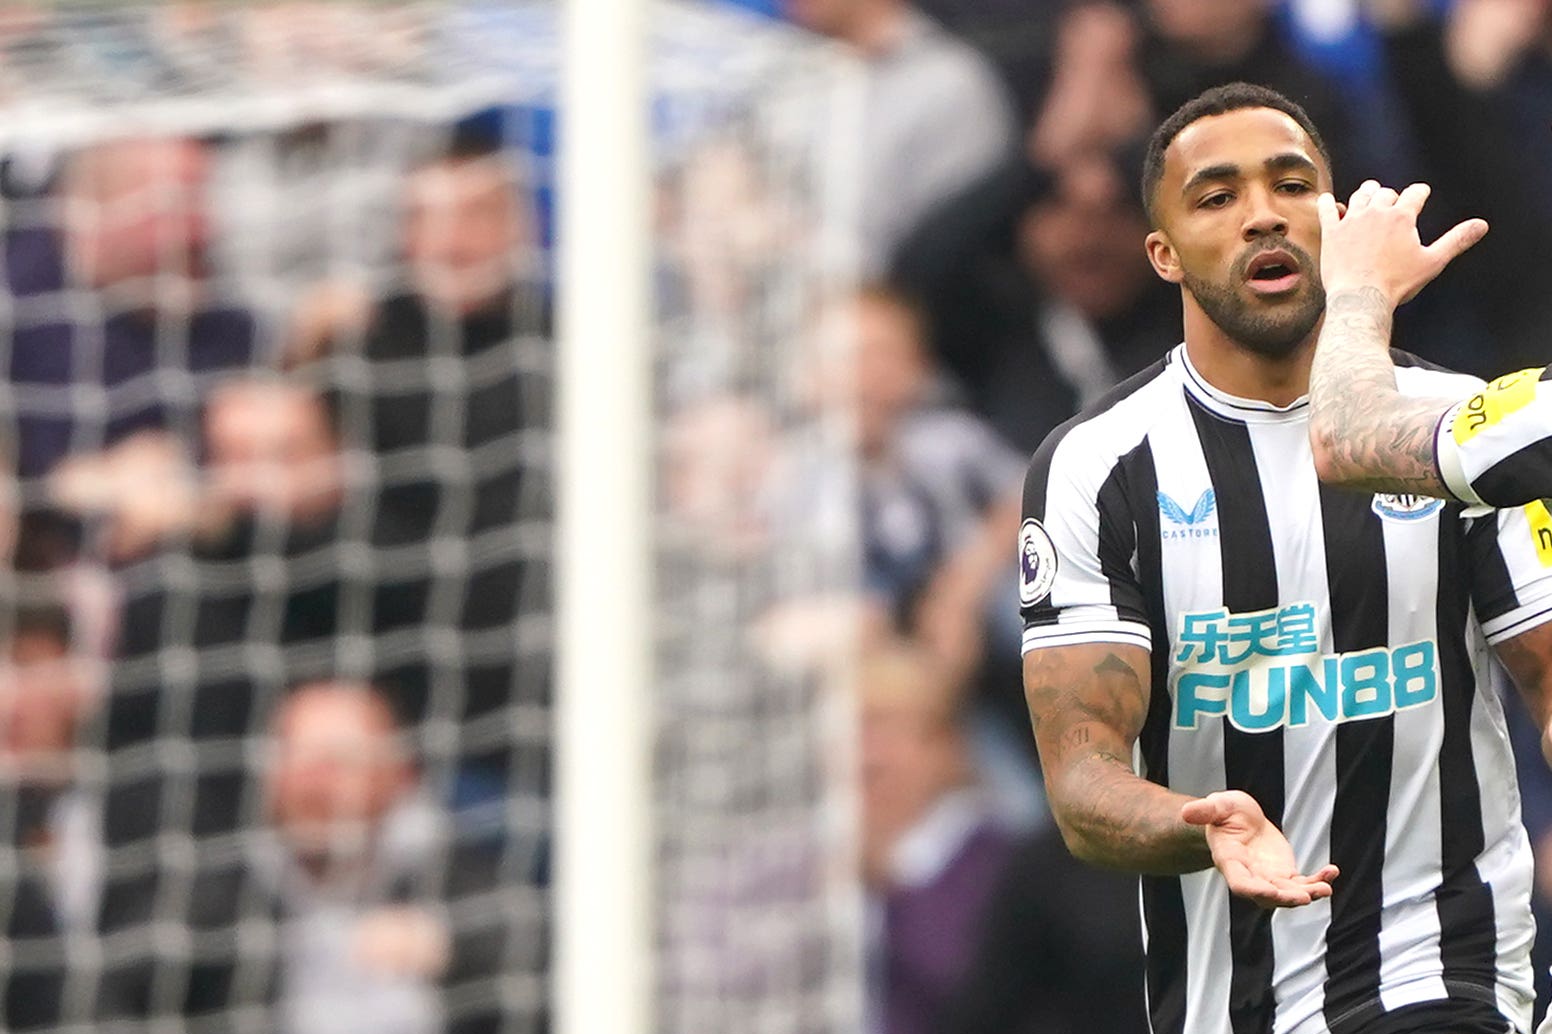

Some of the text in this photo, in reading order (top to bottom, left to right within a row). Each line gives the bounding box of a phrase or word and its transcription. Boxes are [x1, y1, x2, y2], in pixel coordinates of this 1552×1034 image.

[1162, 528, 1218, 540] CASTORE
[1175, 602, 1319, 667] 乐天堂
[1173, 640, 1438, 730] FUN88
